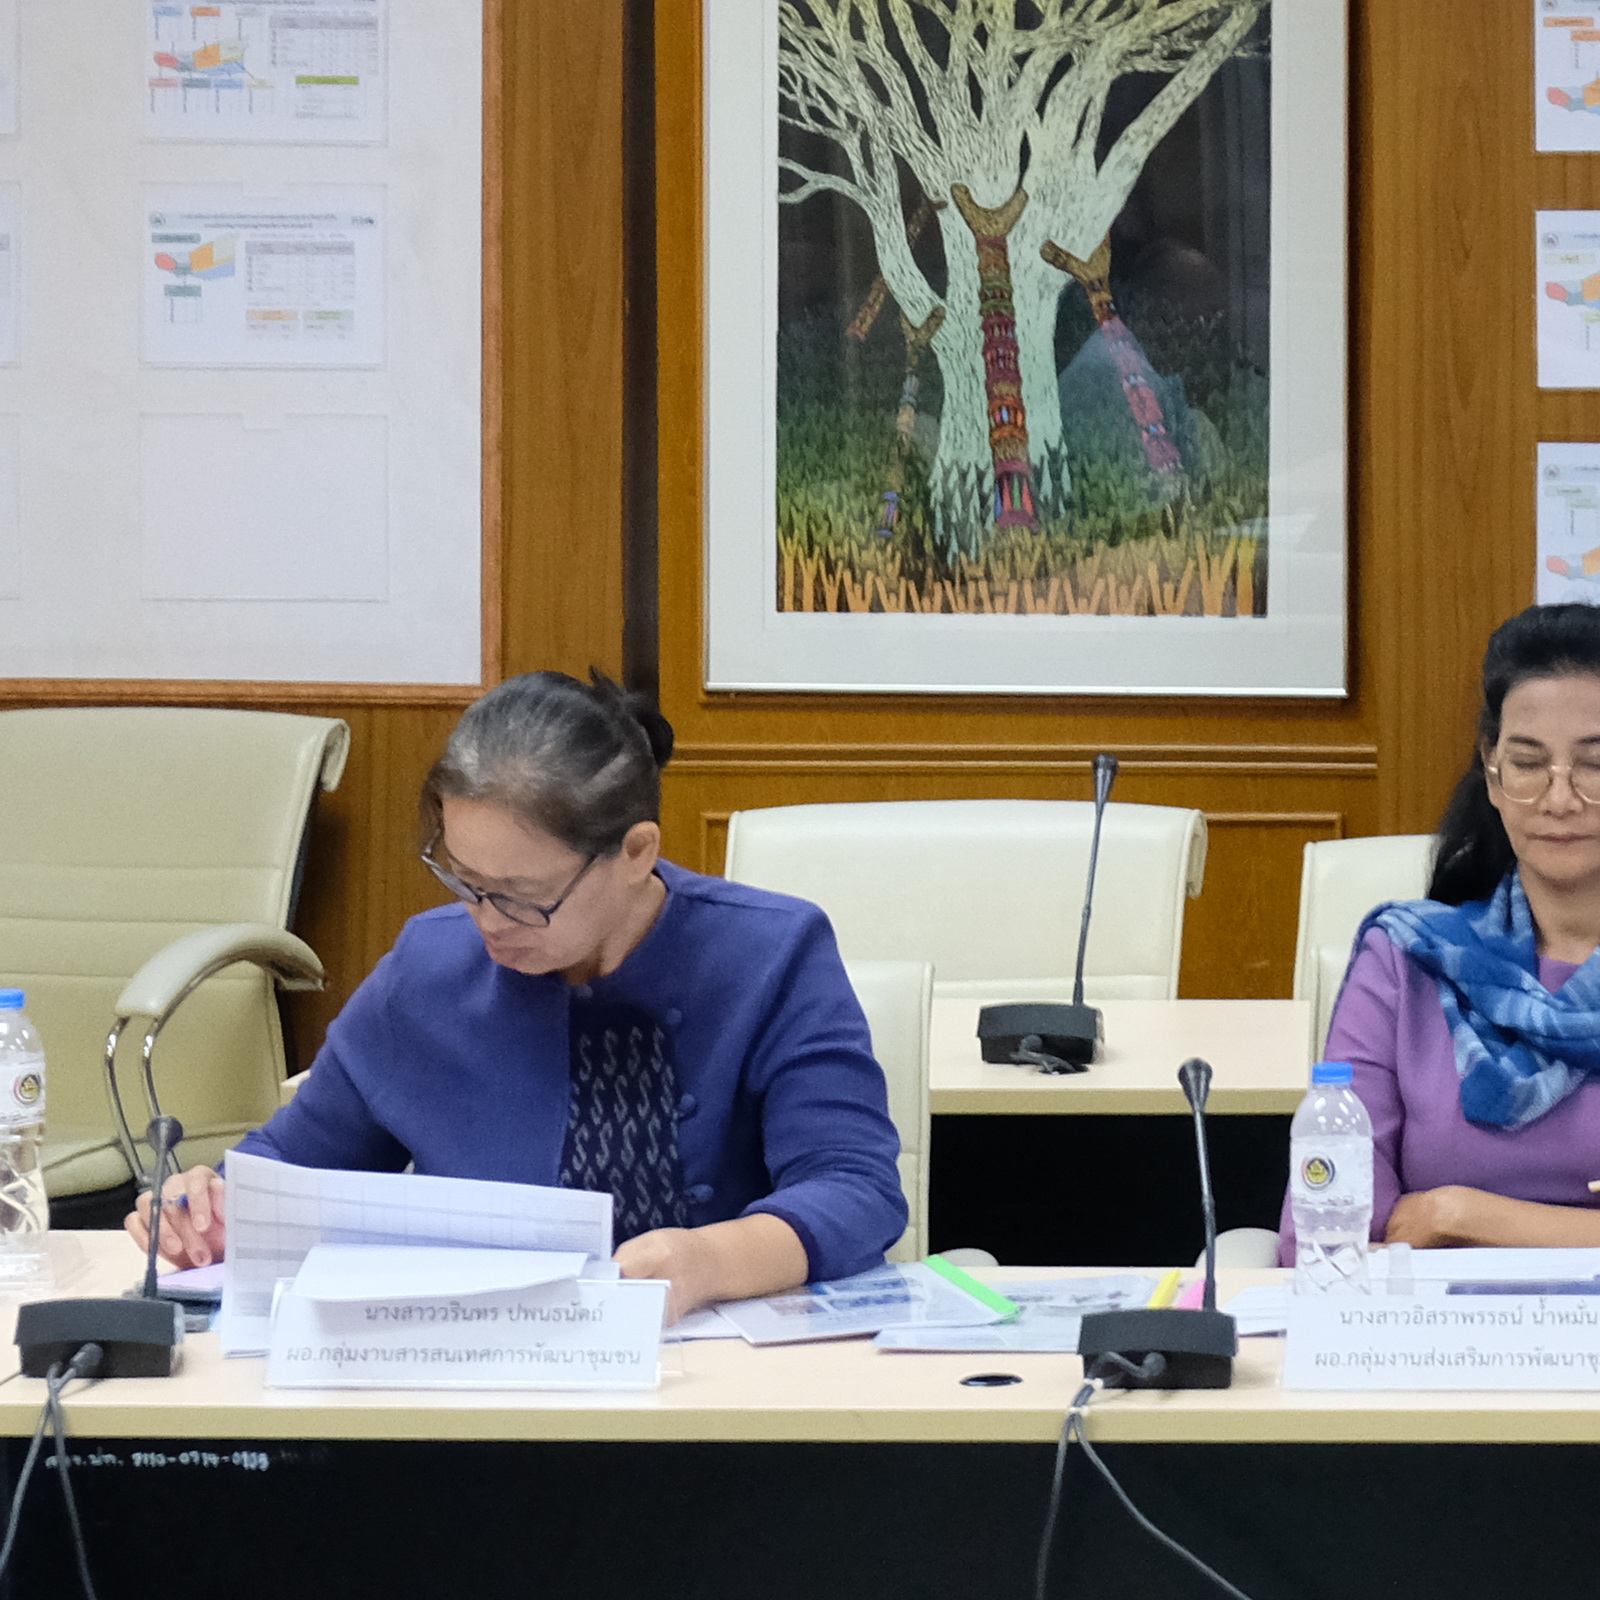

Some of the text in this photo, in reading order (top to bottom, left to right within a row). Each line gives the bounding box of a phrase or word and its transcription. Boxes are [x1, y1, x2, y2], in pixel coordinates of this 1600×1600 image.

[287, 1343, 641, 1370] ผอ.กลุ่มงานสารสนเทศการพัฒนาชุมชน
